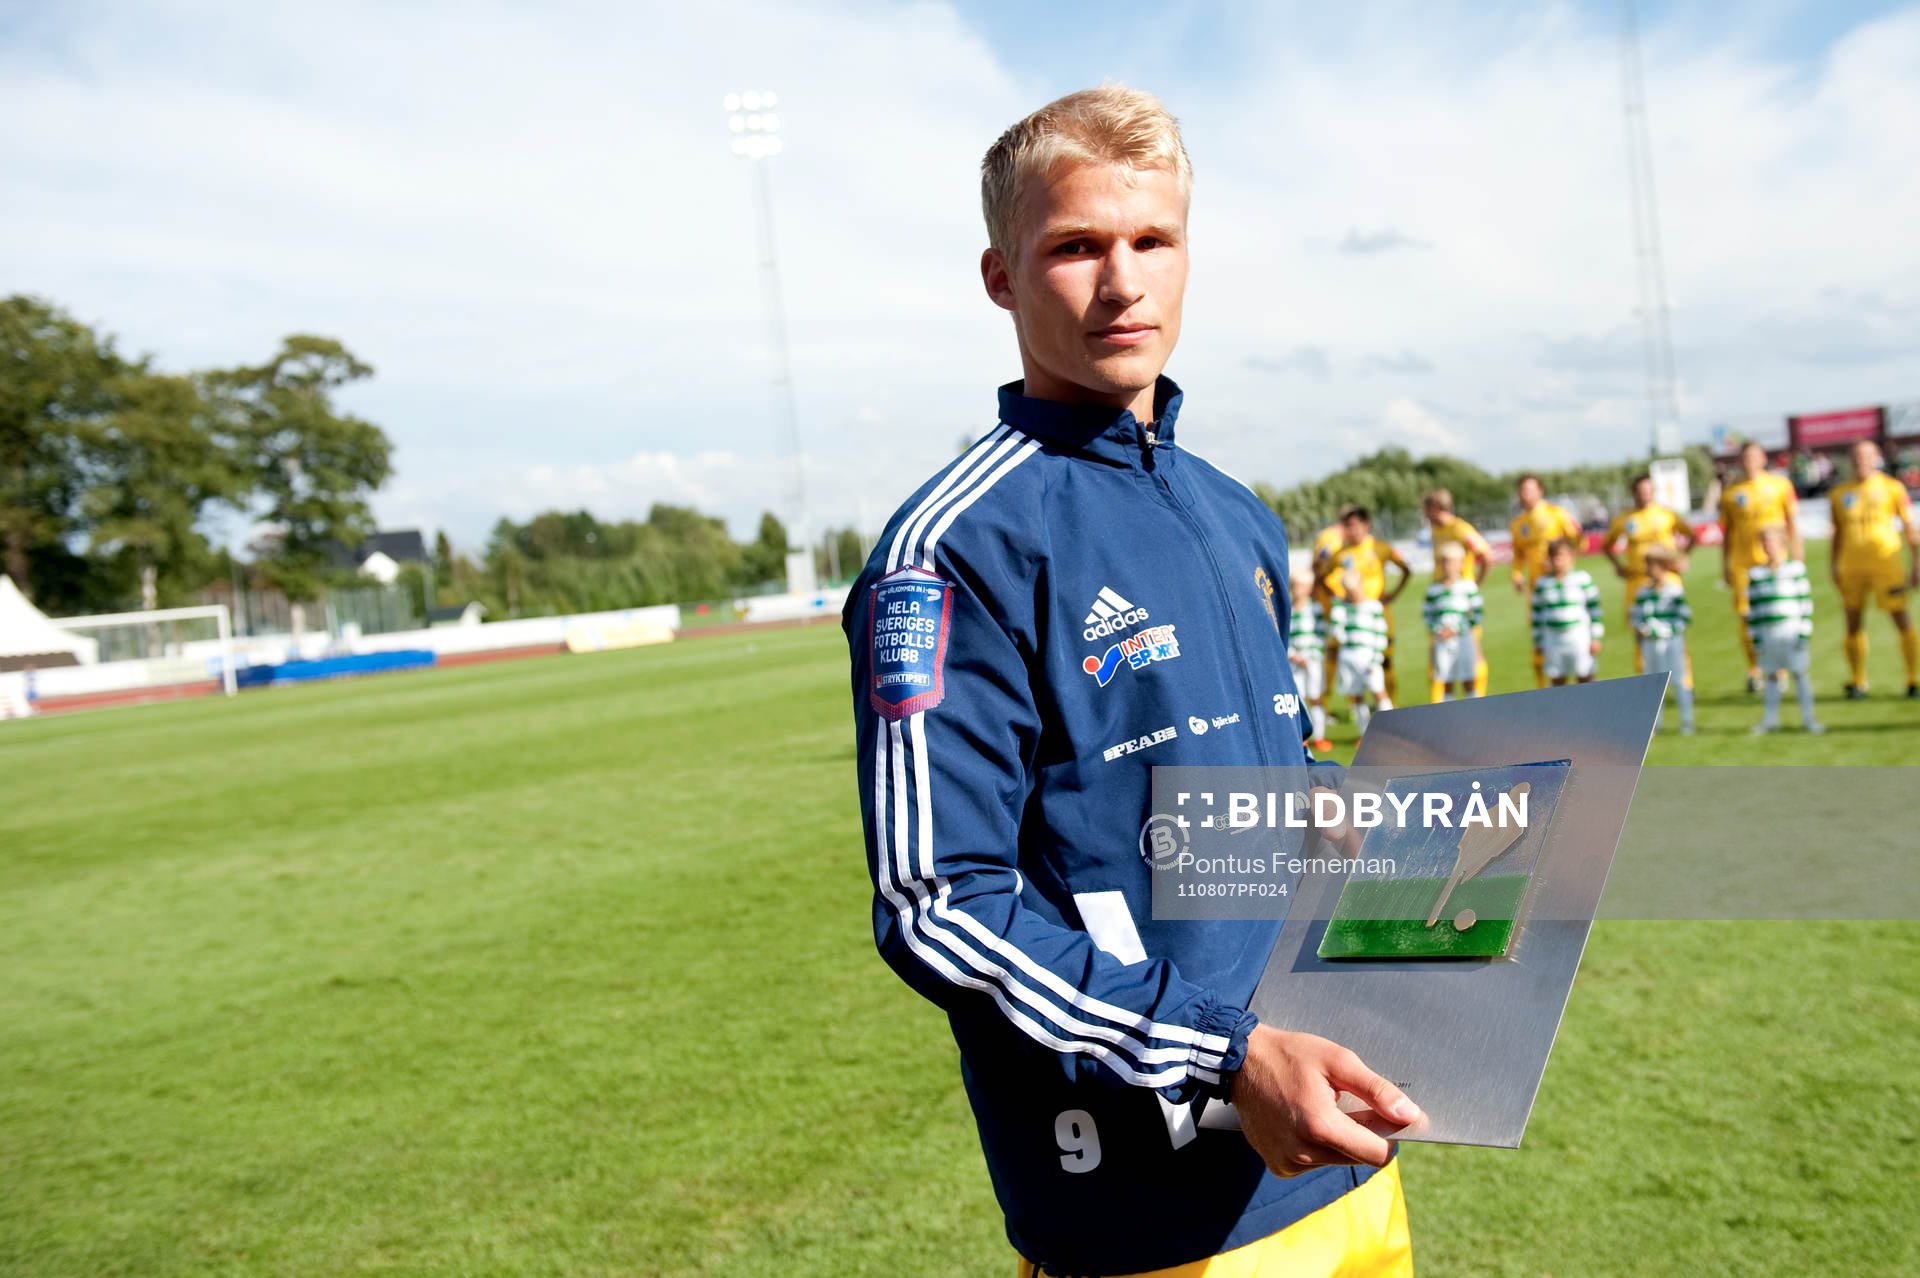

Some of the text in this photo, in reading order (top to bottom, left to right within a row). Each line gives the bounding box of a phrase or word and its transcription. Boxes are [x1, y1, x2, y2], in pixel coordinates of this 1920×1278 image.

[887, 601, 920, 615] HELA
[876, 616, 935, 633] SVERIGES
[1083, 606, 1150, 641] adidas
[874, 632, 935, 649] FOTBOLLS
[1121, 626, 1174, 656] INTER
[880, 649, 919, 663] KLUBB
[1129, 643, 1179, 669] SPORT
[882, 673, 928, 685] STRYKTIPSET
[1110, 729, 1168, 760] PEAB
[1054, 1109, 1102, 1174] 9
